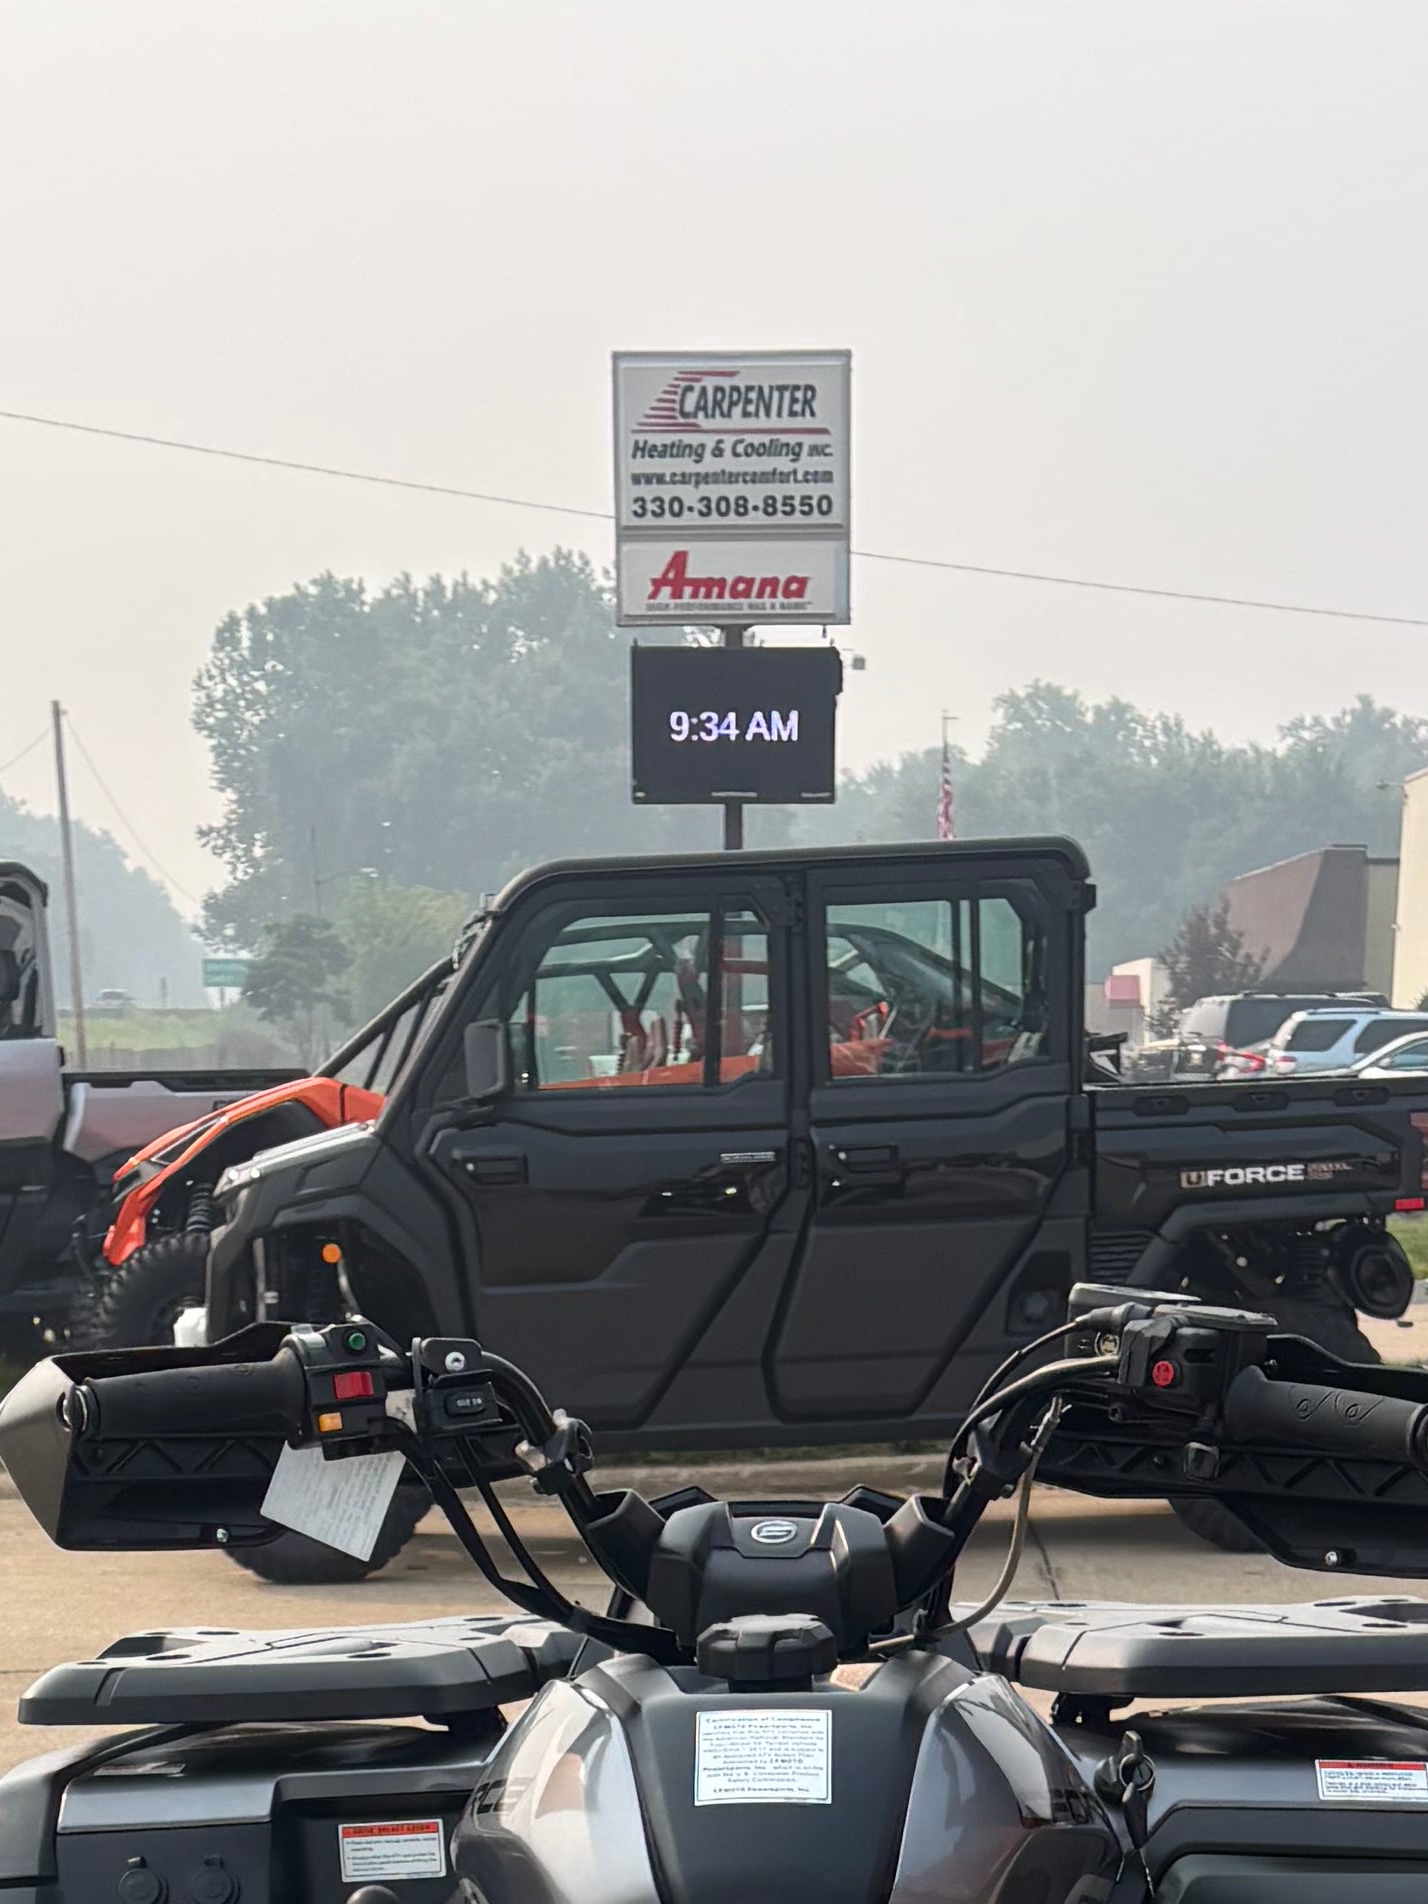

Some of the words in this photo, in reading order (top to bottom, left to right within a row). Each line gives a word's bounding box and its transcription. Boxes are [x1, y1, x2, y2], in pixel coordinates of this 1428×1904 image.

[679, 384, 817, 419] CARPENTER
[631, 439, 706, 464] Heating
[711, 439, 725, 458] &
[731, 438, 804, 463] Cooling
[630, 468, 834, 488] www.carpentercomfort.com
[647, 550, 811, 600] Amana
[670, 711, 740, 741] 9:34
[745, 710, 799, 741] AM
